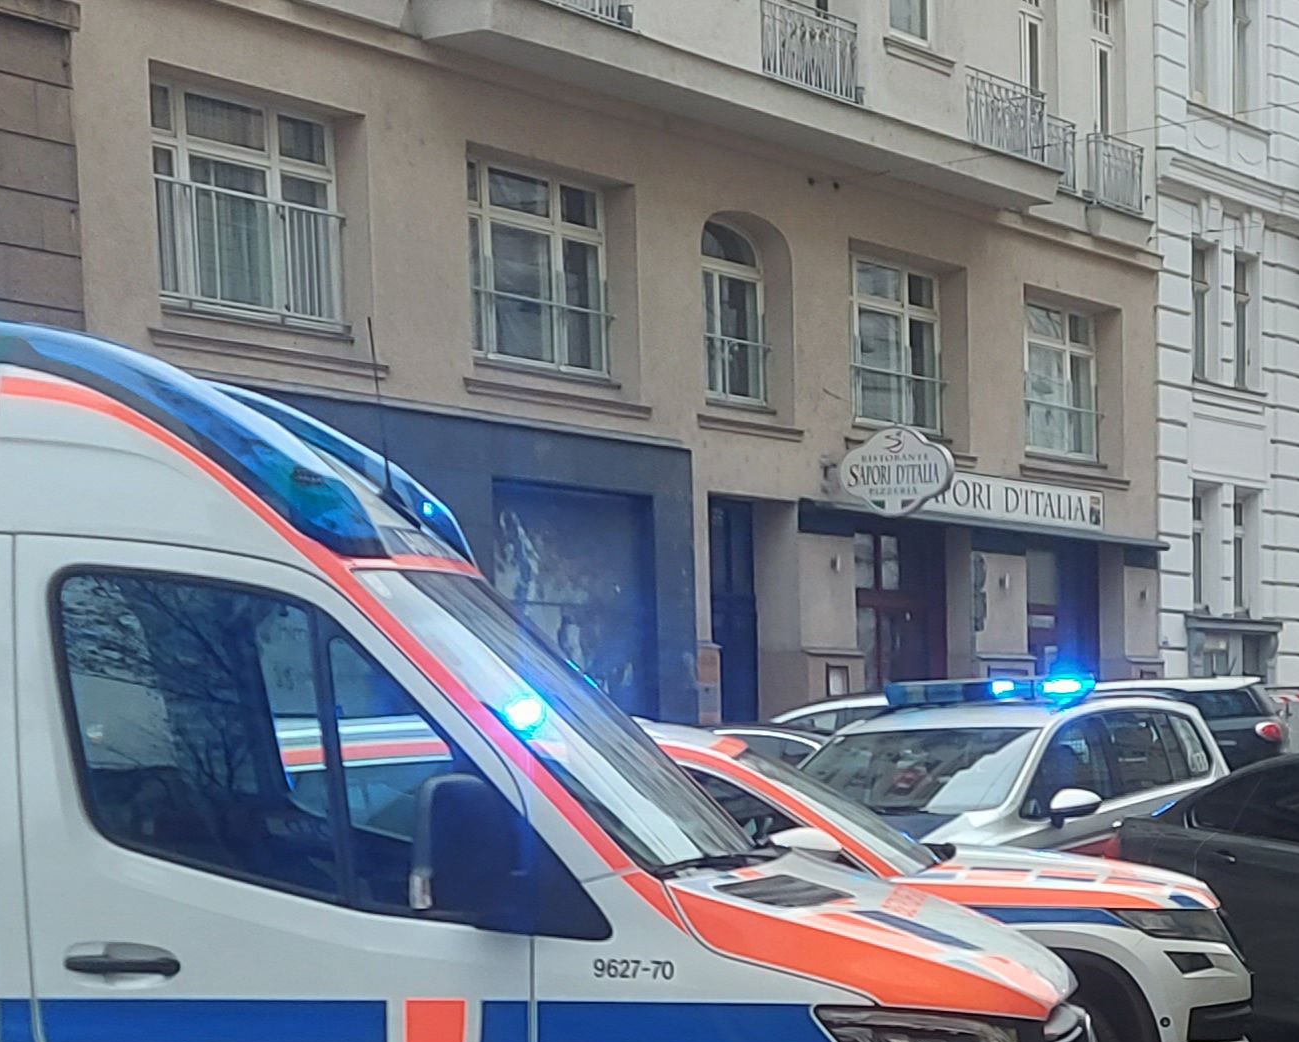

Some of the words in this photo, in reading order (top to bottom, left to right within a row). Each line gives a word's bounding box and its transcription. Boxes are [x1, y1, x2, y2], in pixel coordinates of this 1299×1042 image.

[847, 463, 892, 488] SAPORI
[868, 486, 918, 496] PIZZERIA
[1004, 486, 1086, 522] D'ITALIA
[593, 958, 675, 980] 9627-70
